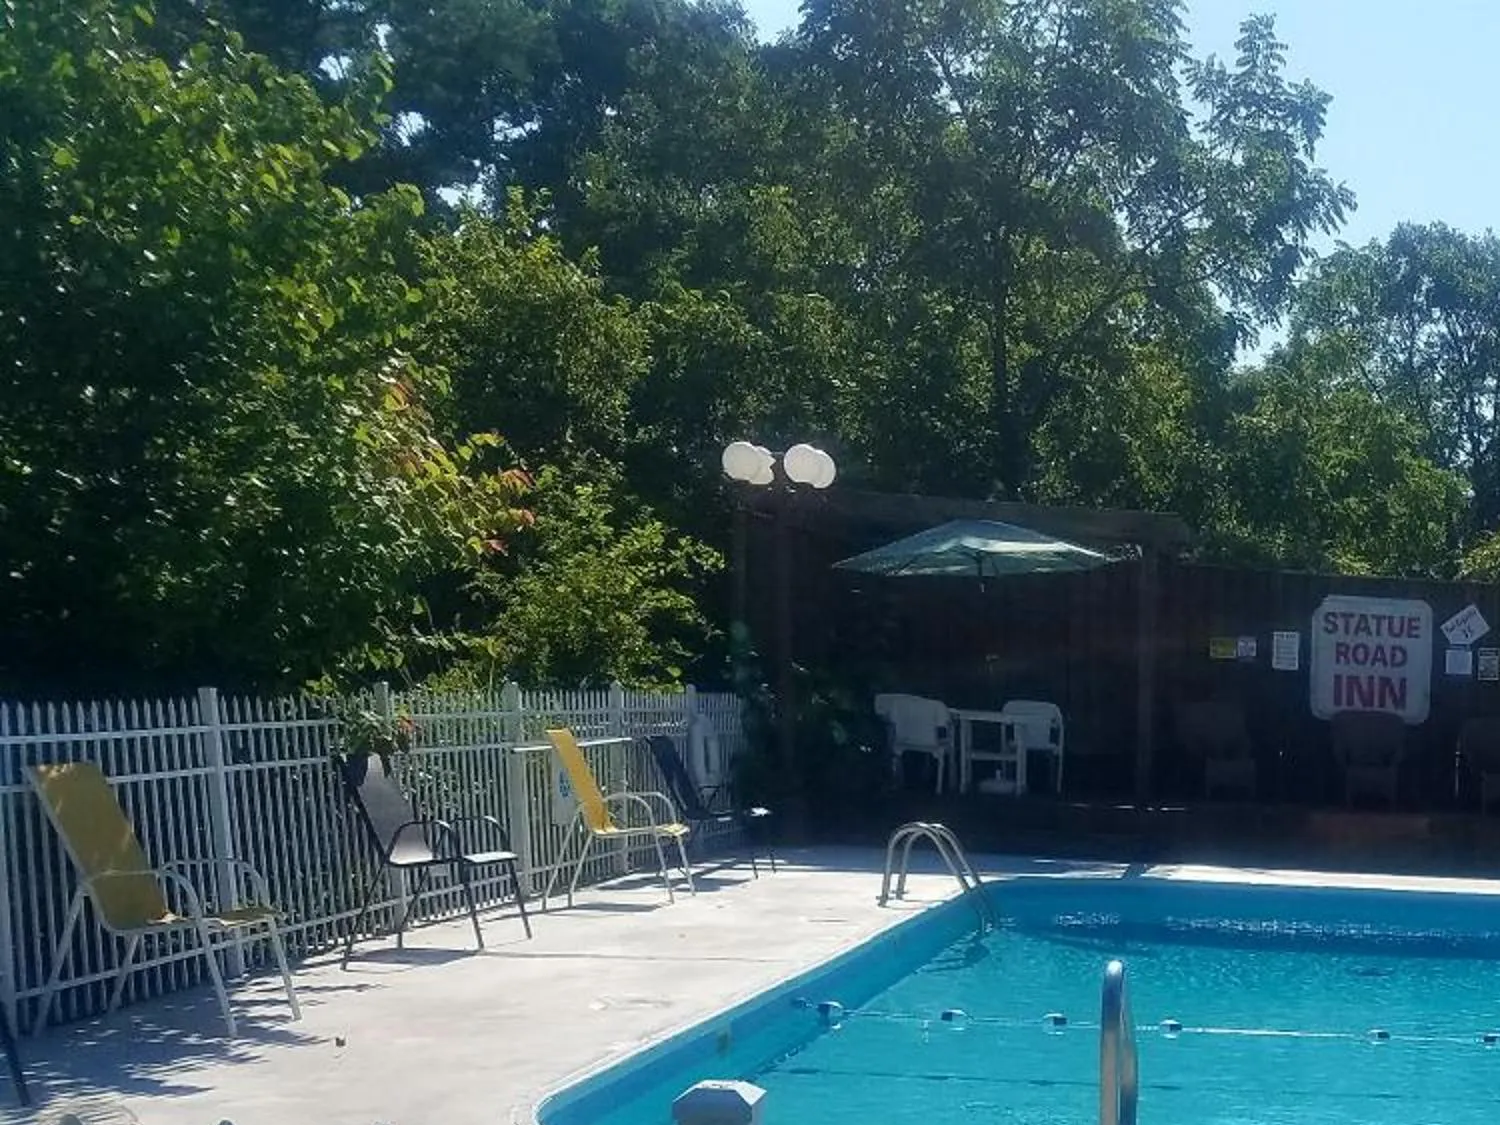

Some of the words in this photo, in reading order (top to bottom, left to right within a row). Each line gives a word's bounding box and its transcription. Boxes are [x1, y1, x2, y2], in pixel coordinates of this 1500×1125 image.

[1323, 611, 1421, 639] STATUE
[1335, 642, 1408, 668] ROAD
[1333, 674, 1407, 709] INN
